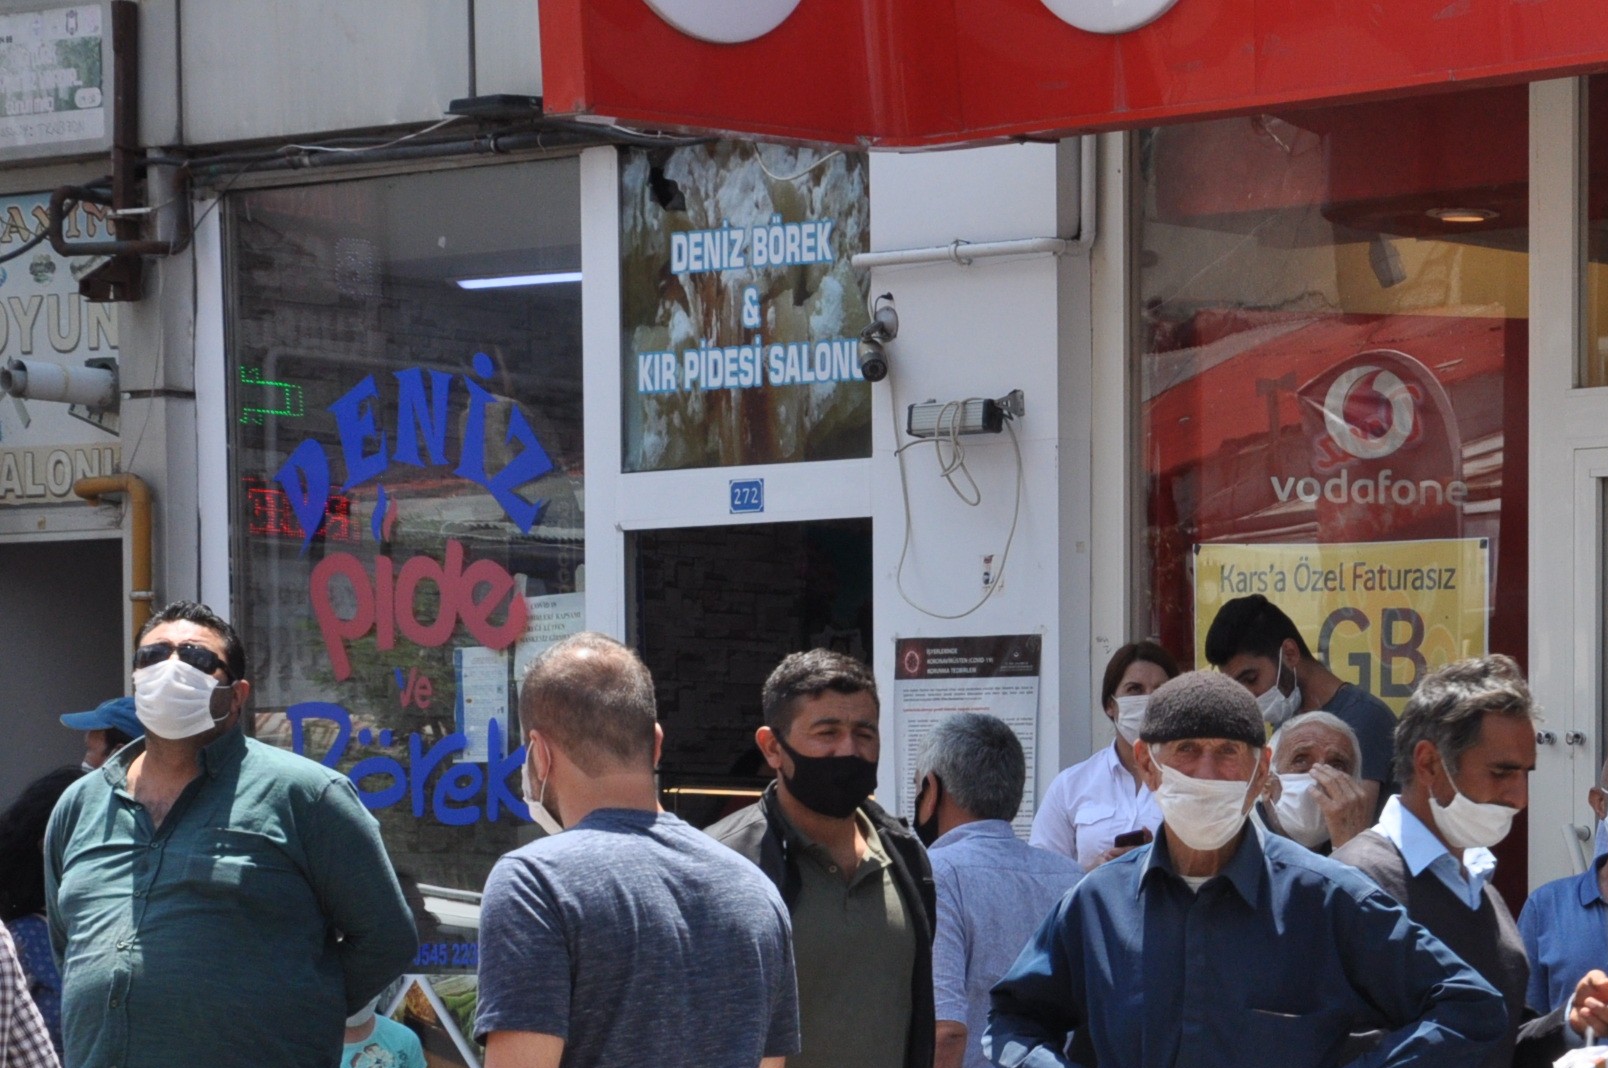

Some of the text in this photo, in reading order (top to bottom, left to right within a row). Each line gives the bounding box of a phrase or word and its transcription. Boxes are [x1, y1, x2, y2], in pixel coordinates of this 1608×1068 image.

[671, 213, 834, 275] DENİZ BÖREK
[0, 293, 119, 355] YUN
[742, 285, 761, 329] &
[637, 351, 677, 394] KIR
[683, 334, 763, 392] PİDESİ
[733, 486, 759, 505] 272
[1270, 468, 1469, 506] vodafone
[1294, 556, 1346, 592] Özel
[1352, 561, 1456, 592] Faturasız
[1318, 606, 1427, 698] GB
[394, 667, 433, 709] ve
